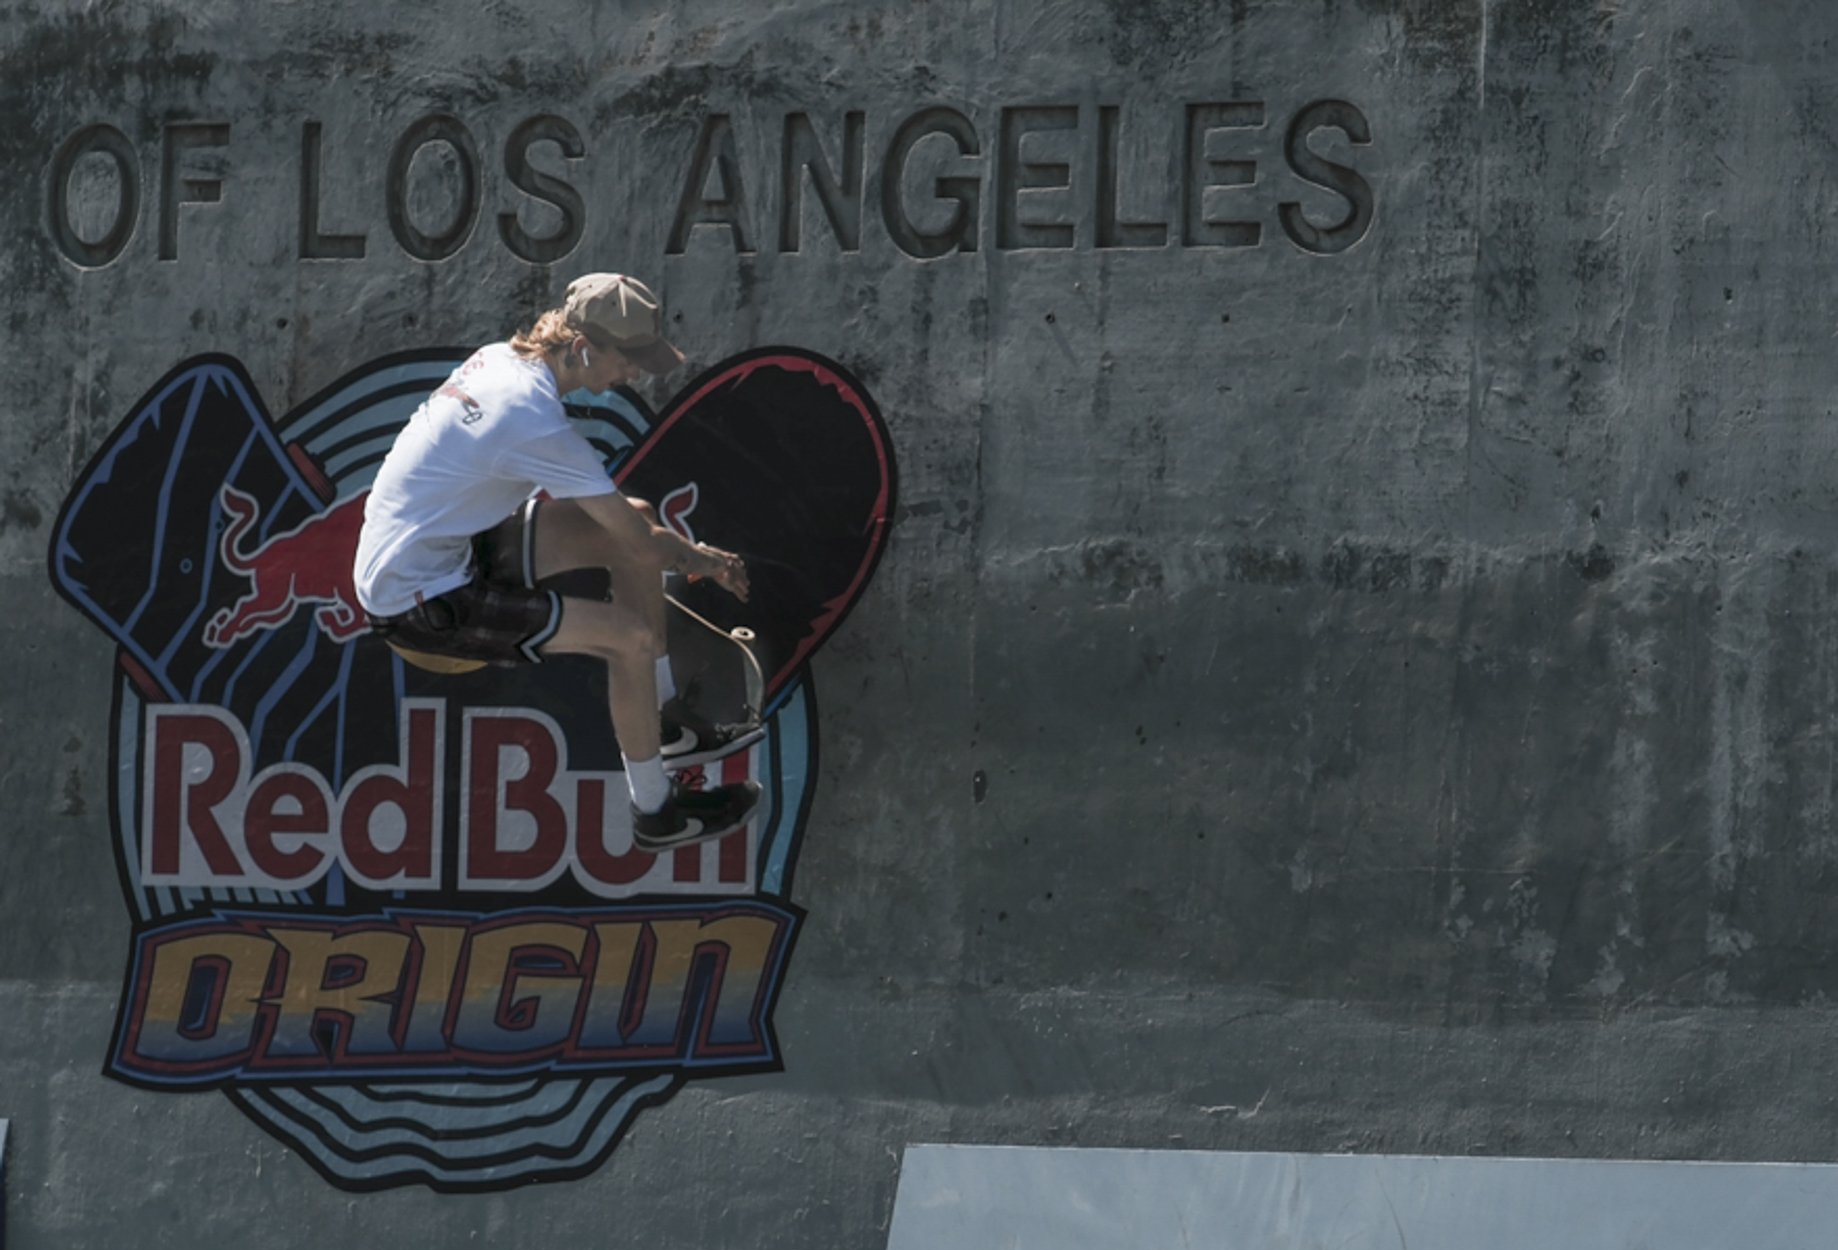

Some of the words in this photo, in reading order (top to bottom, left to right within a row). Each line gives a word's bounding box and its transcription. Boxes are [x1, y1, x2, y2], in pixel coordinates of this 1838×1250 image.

[48, 121, 230, 270] OF
[299, 113, 586, 264] LOS
[664, 98, 1376, 260] ANGELES
[149, 706, 437, 882] Red
[125, 910, 787, 1068] ORIGIN
